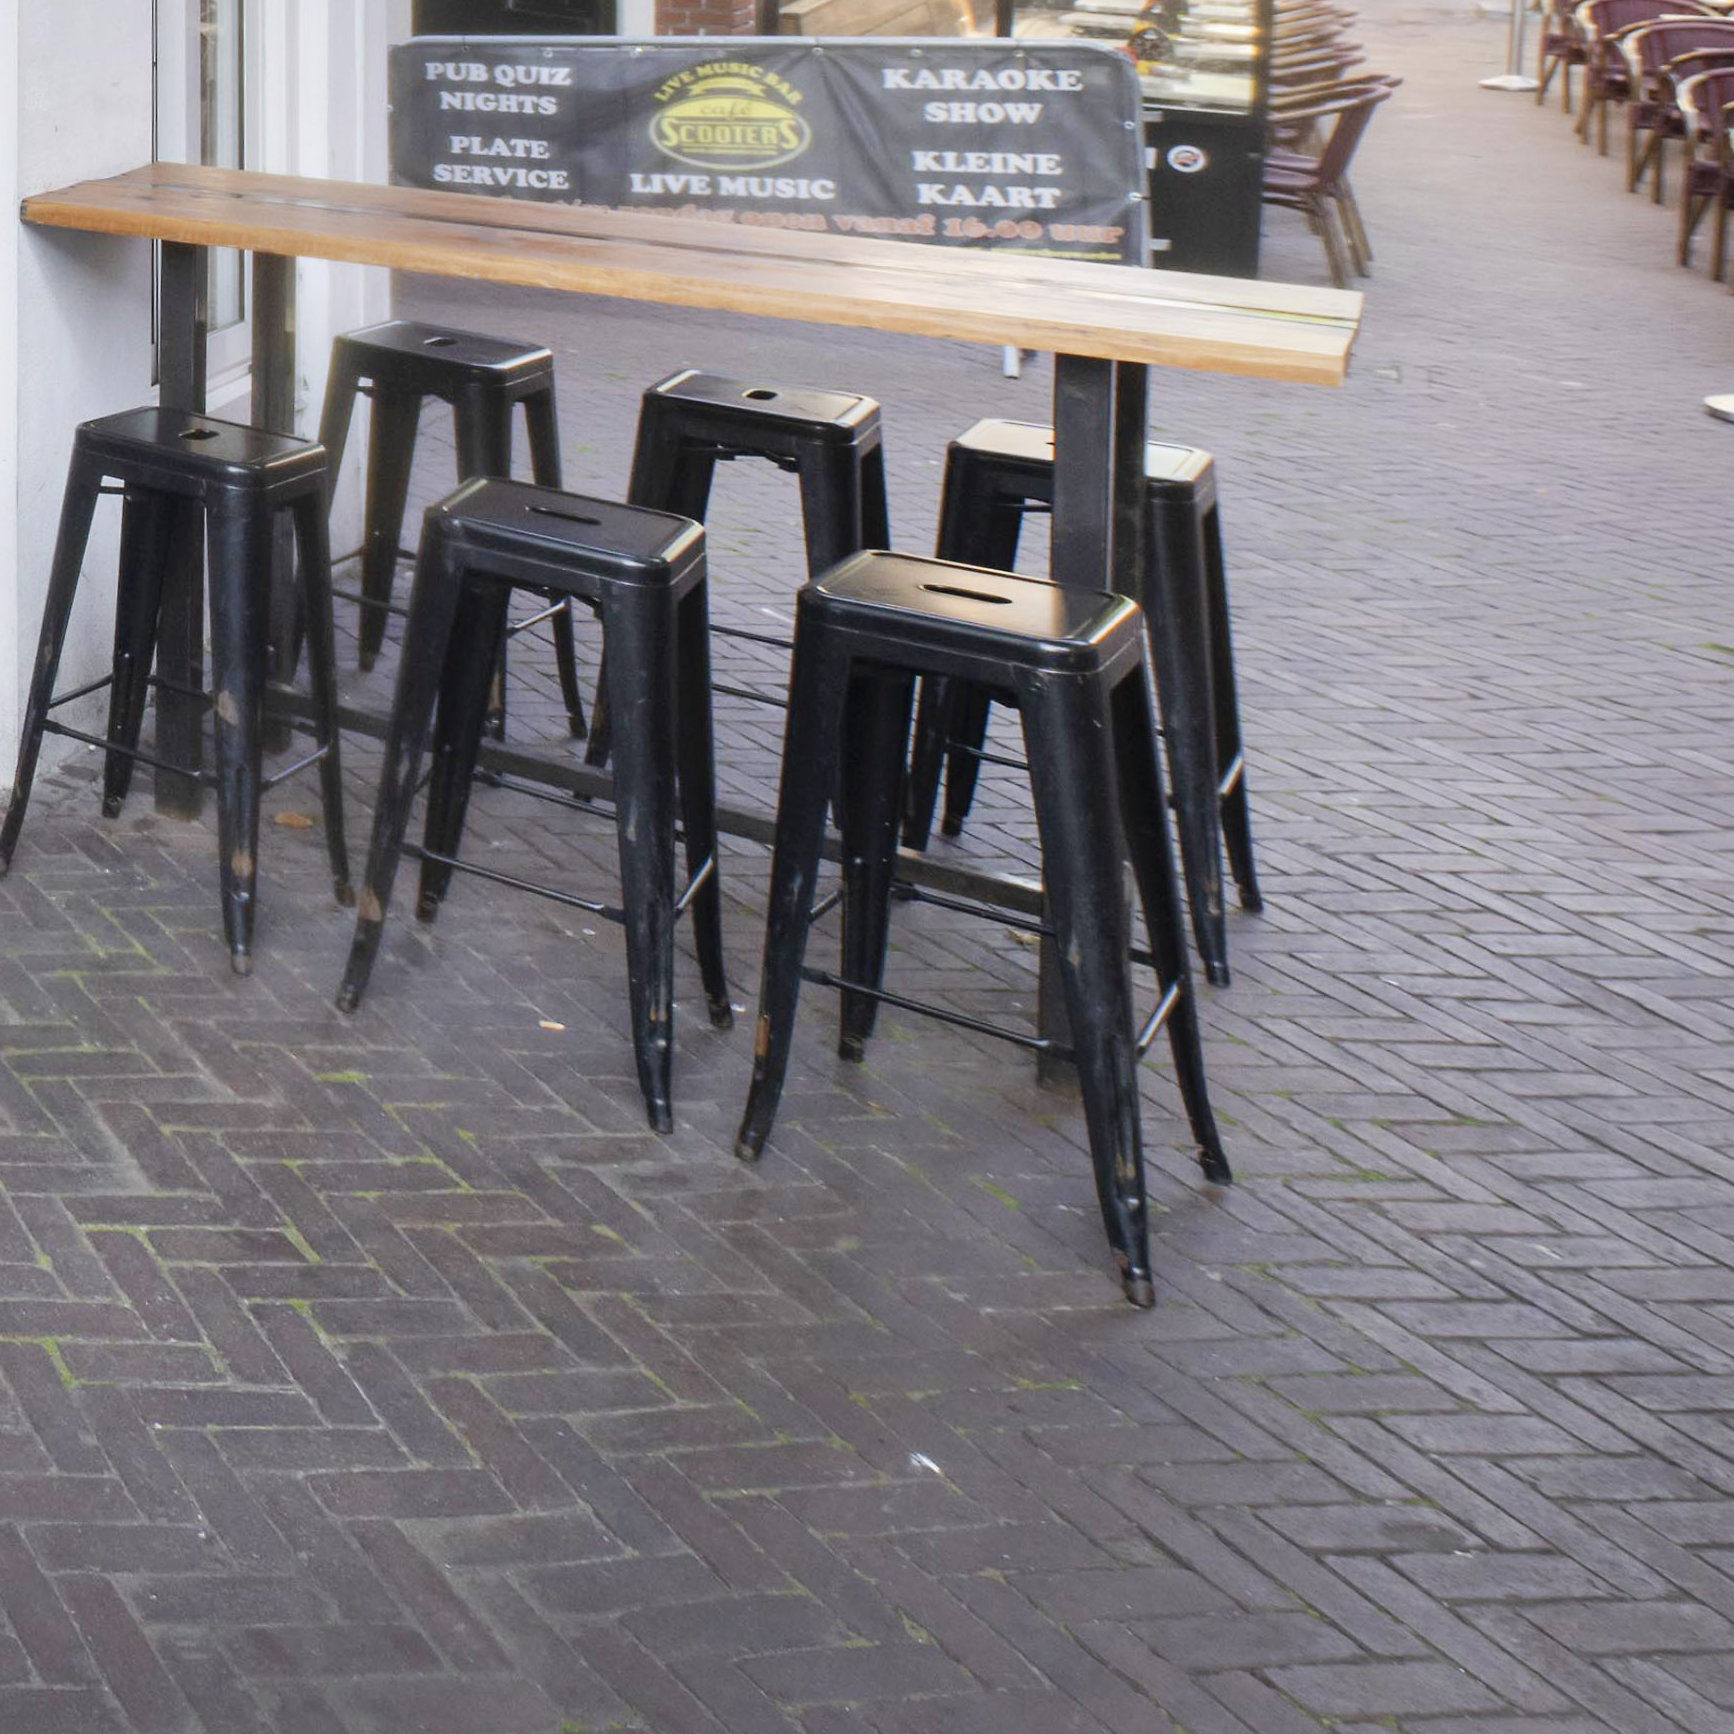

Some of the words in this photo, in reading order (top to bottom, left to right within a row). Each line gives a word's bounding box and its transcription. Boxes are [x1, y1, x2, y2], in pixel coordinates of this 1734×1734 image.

[425, 62, 488, 82] PUB
[494, 65, 572, 87] QUIZ
[654, 71, 694, 102] LIVE
[696, 62, 763, 78] MUSIC
[763, 72, 803, 105] BAR
[882, 68, 1084, 92] KARAOKE
[439, 91, 558, 115] NIGHTS
[924, 101, 1044, 124] SHOW
[450, 135, 550, 159] PLATE
[911, 150, 1064, 175] KLEINE
[433, 164, 570, 190] SERVICE
[630, 173, 711, 195] LIVE
[717, 176, 836, 200] MUSIC
[916, 183, 1063, 209] KAART
